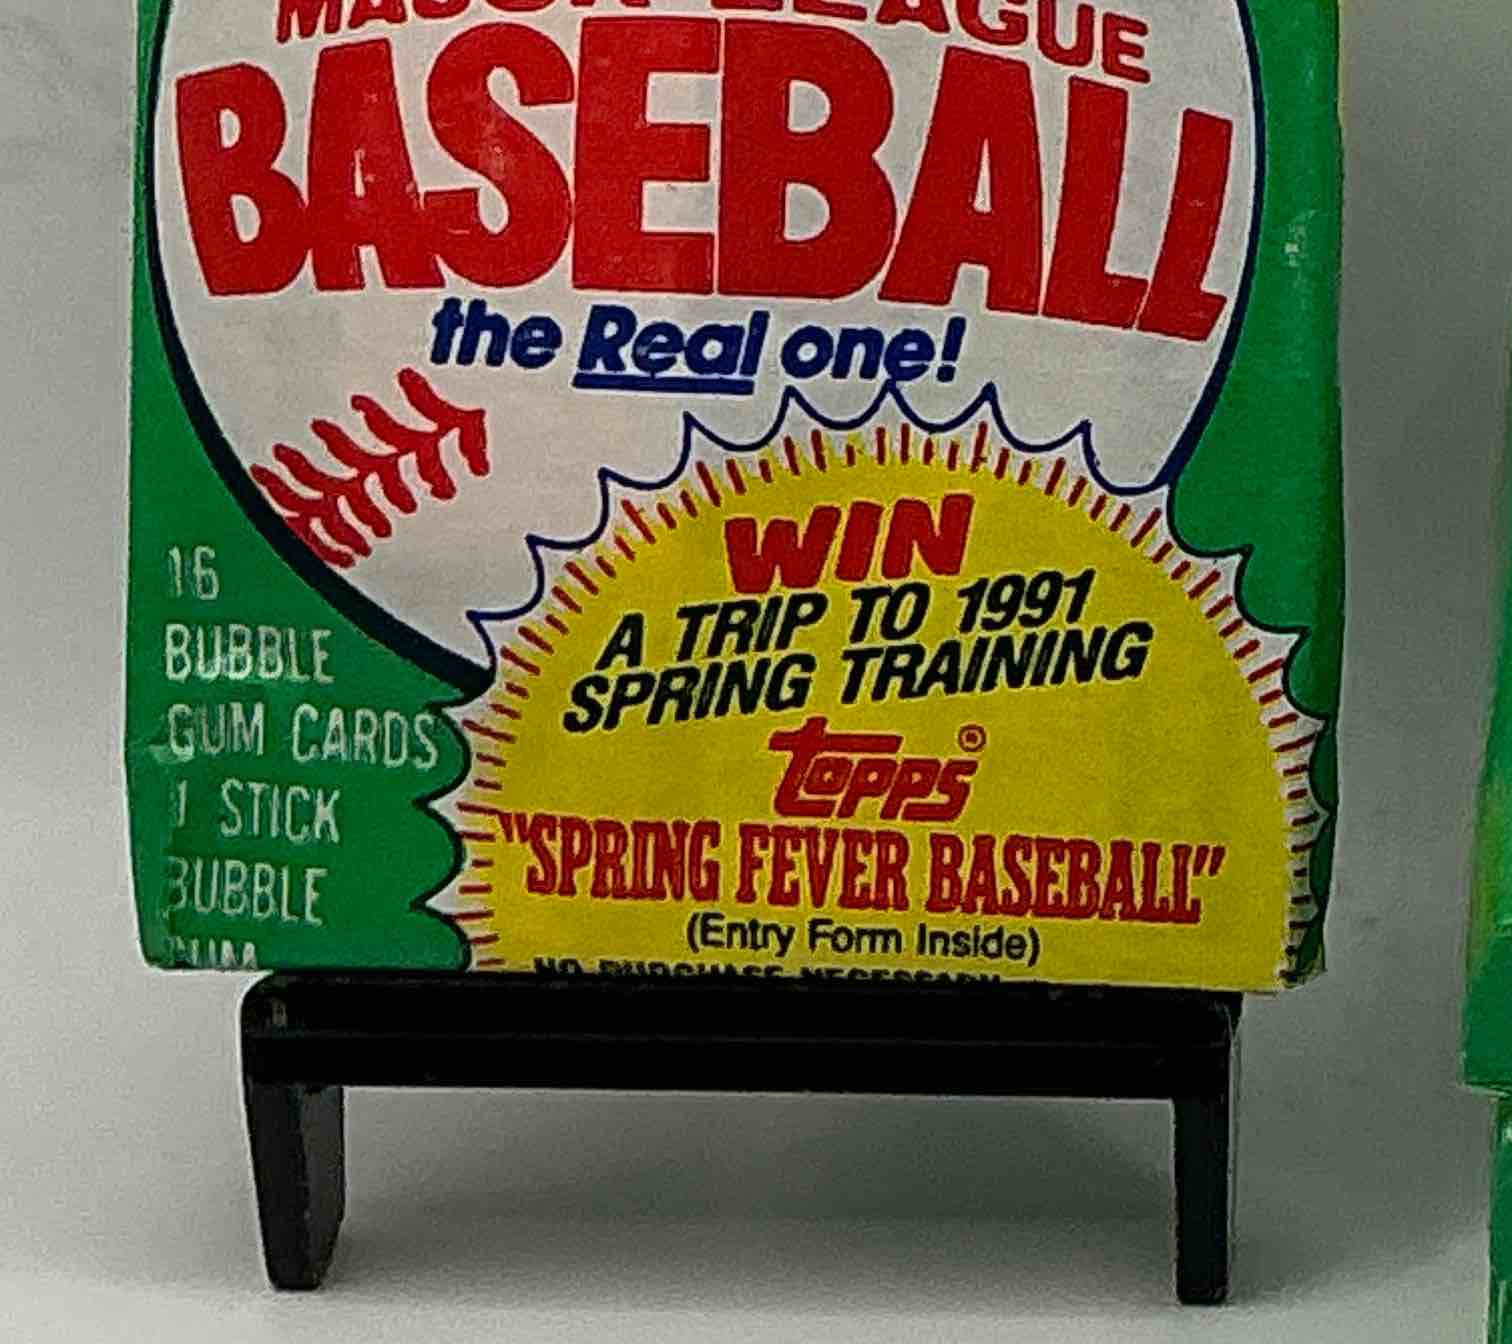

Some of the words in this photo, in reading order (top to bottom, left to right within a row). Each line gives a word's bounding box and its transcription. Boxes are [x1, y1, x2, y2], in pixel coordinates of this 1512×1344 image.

[176, 16, 1236, 343] BASEBALL
[430, 296, 562, 372] the
[574, 310, 762, 396] Real
[781, 316, 965, 384] one!
[168, 545, 220, 600] 16
[723, 493, 975, 594] WIN
[164, 623, 336, 683] BUBBLE
[595, 613, 644, 671] A
[676, 592, 827, 662] TRIP
[850, 582, 932, 643] TO
[955, 568, 1097, 632] 1991
[563, 655, 816, 733] SPRING
[840, 621, 1153, 704] TRAINING
[167, 702, 265, 757] GUM
[291, 704, 440, 770] CARDS
[174, 779, 188, 827] 1
[220, 778, 341, 843] STICK
[500, 812, 720, 902] "SPRING
[736, 823, 910, 911] FEVER
[924, 833, 1226, 924] BASEBALL"
[687, 912, 795, 955] (Entry
[808, 919, 902, 955] Form
[916, 923, 1041, 966] Inside)
